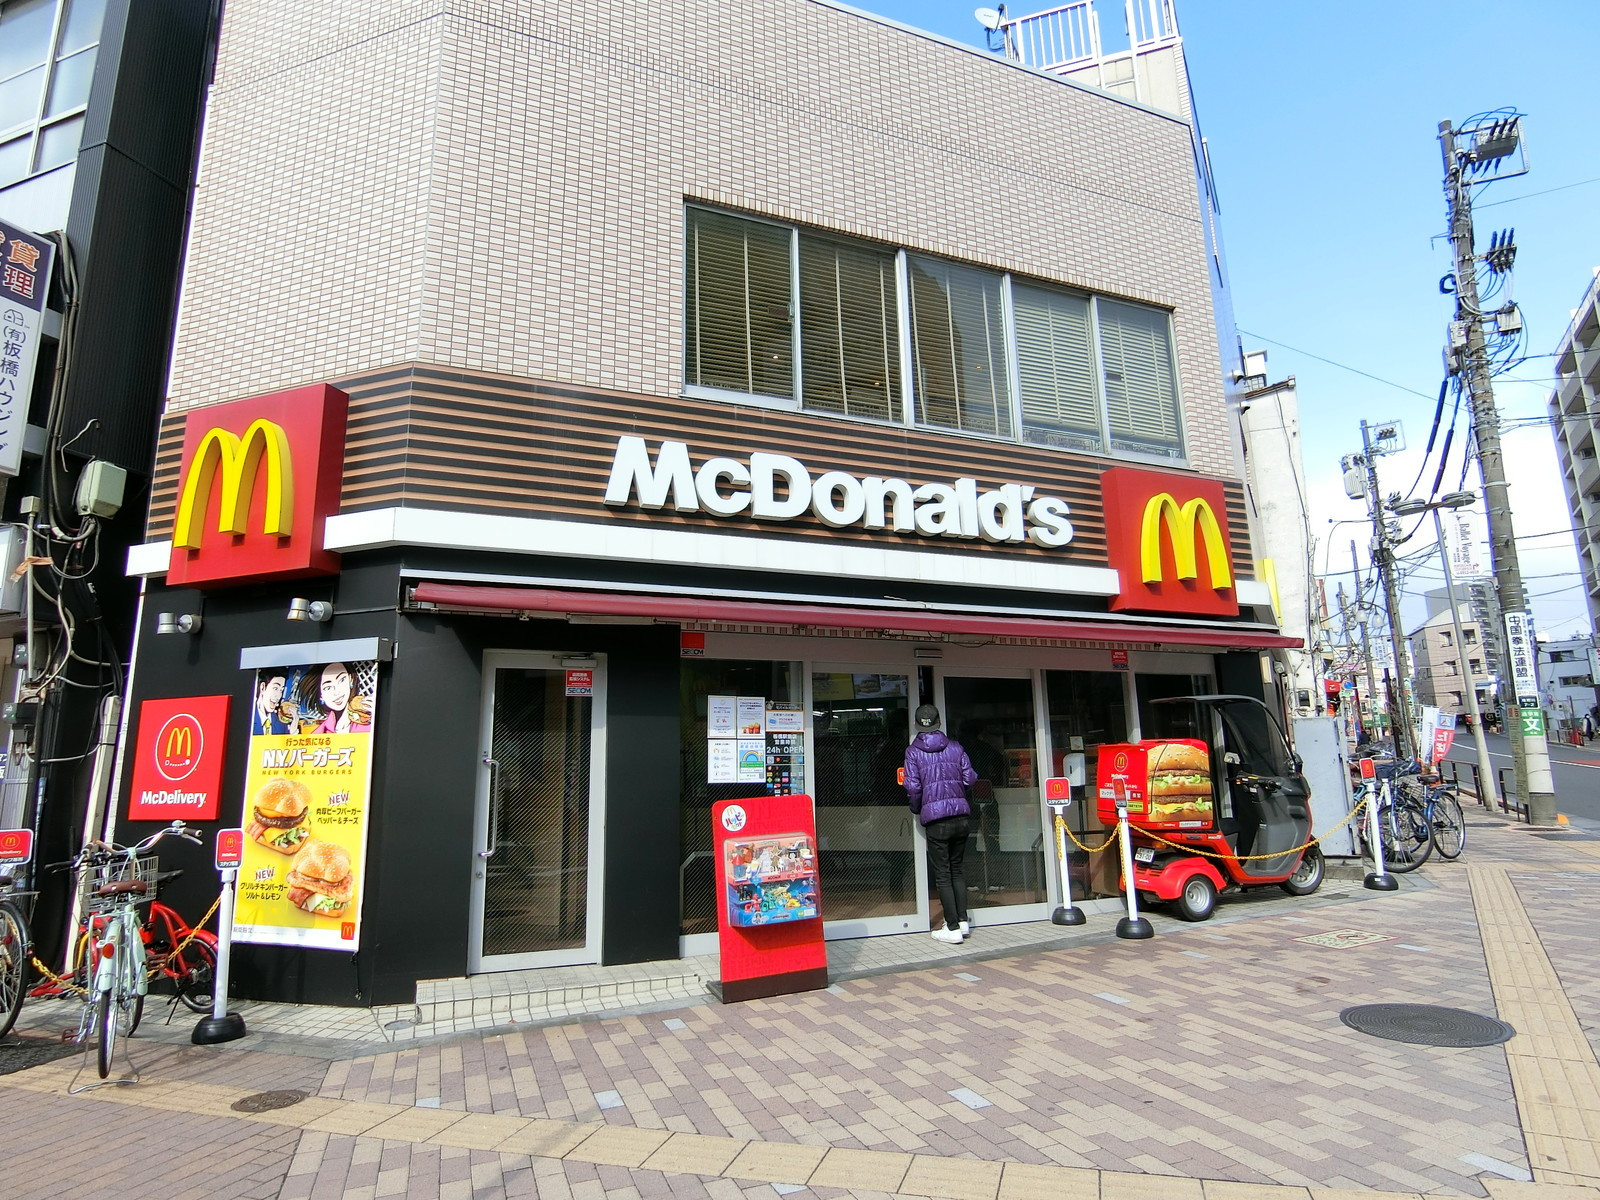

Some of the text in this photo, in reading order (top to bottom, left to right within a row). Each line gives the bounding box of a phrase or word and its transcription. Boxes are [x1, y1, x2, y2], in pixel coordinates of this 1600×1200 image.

[603, 435, 1075, 549] McDonald's
[766, 746, 781, 754] 24h
[783, 745, 804, 754] OPEN
[140, 789, 207, 808] McDelivery
[328, 792, 349, 805] NEW
[255, 868, 275, 880] NEW
